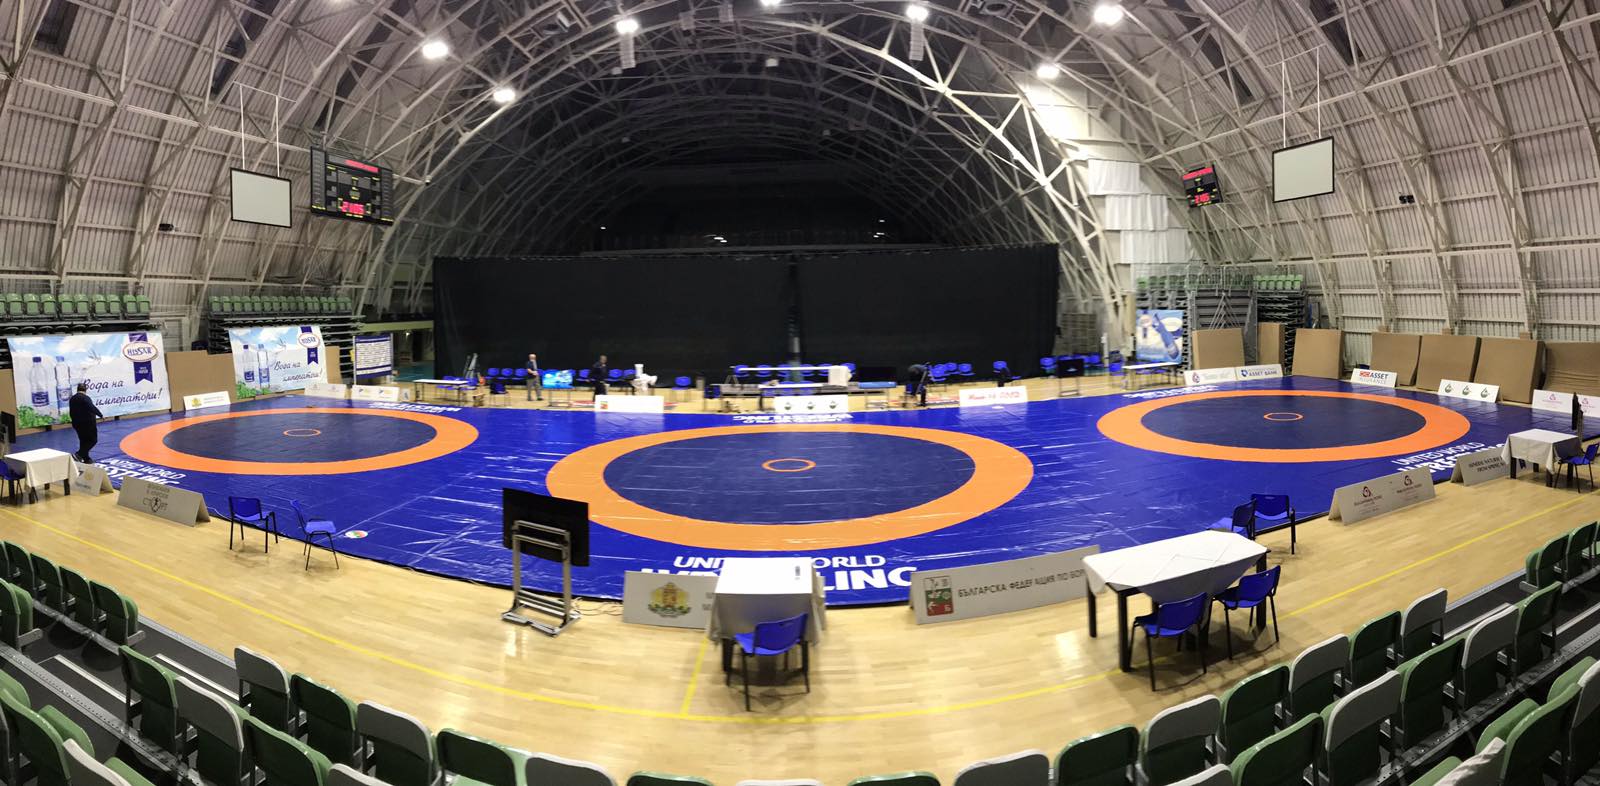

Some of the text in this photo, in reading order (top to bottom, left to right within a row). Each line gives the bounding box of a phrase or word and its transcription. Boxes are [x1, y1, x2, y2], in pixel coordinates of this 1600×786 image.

[84, 378, 124, 393] Вода на
[95, 387, 163, 407] императори!
[673, 555, 887, 569] UNI ORLD
